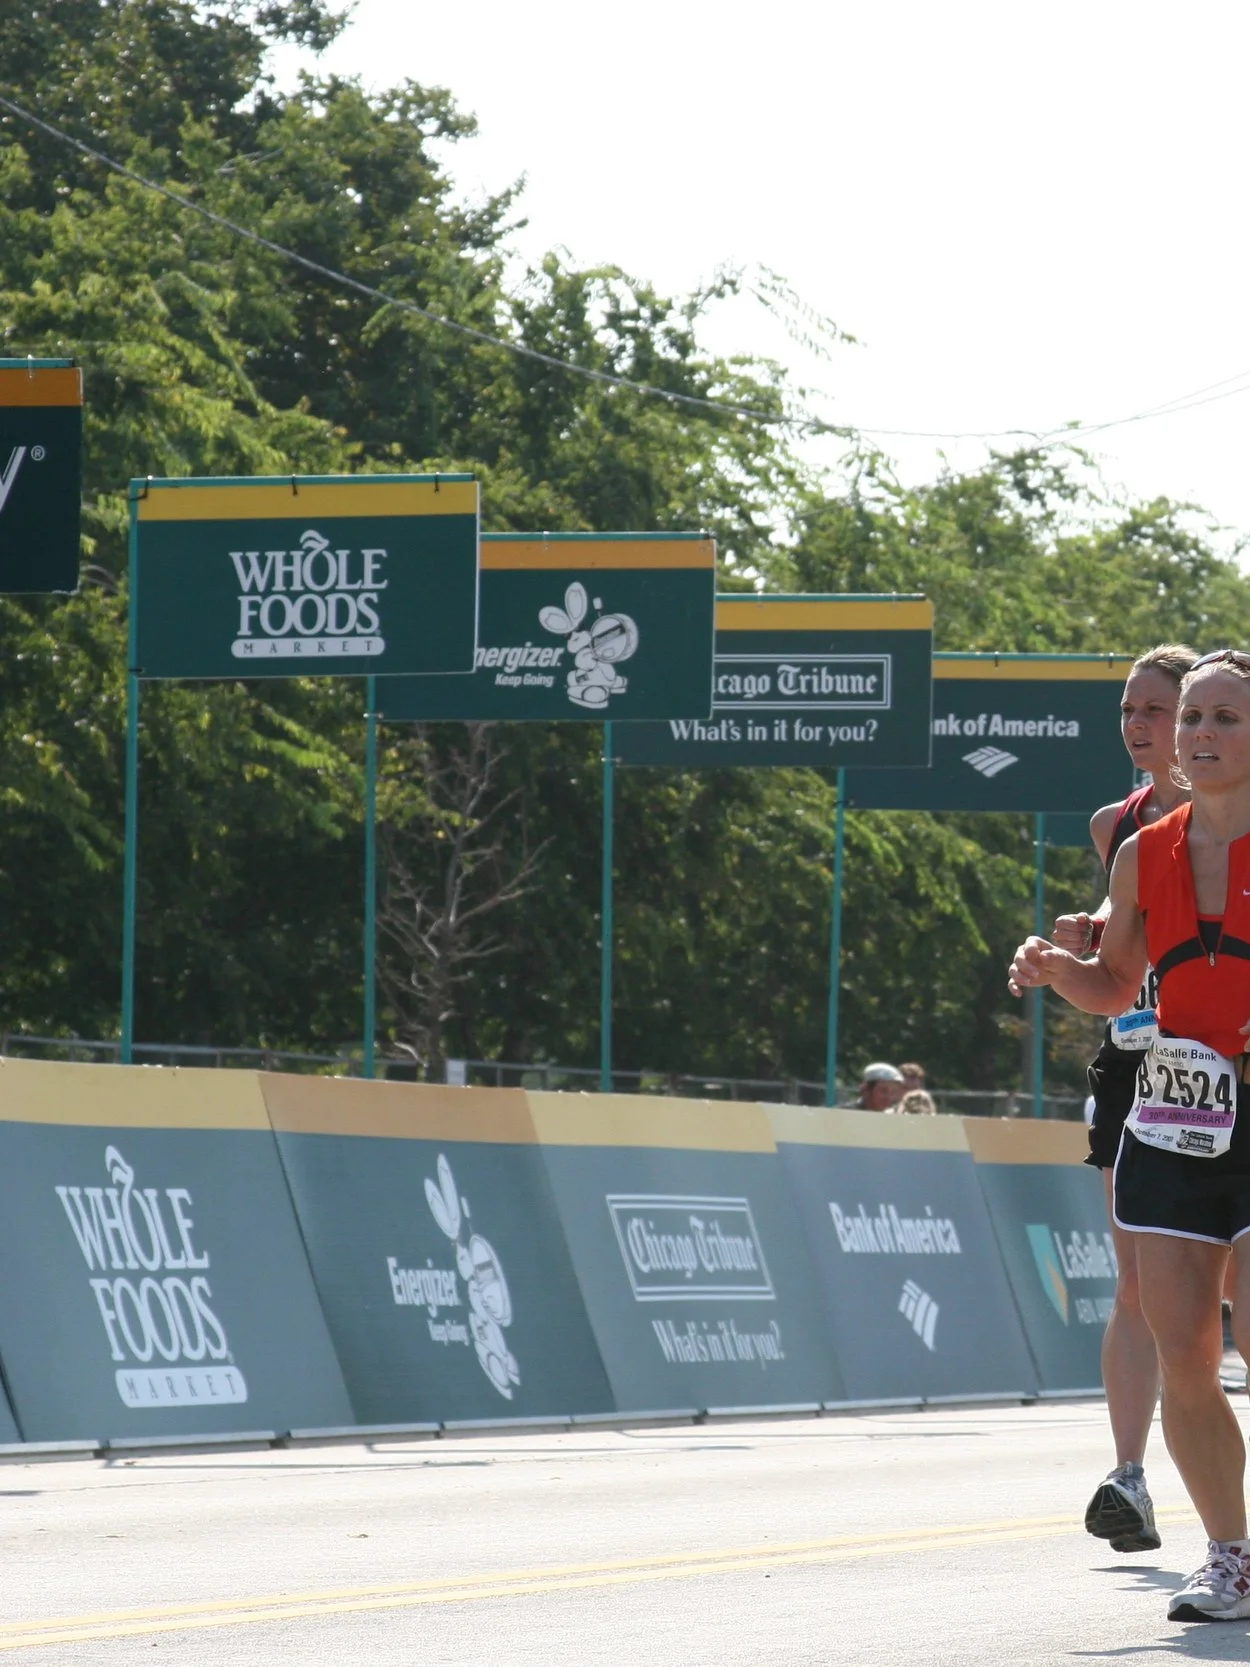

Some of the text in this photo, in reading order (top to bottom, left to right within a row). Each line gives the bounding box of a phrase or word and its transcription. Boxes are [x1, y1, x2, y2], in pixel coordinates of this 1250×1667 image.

[228, 547, 389, 592] WHOLE
[237, 592, 380, 636] FOODS
[243, 640, 374, 655] MARKET
[495, 673, 555, 689] Keep Going
[714, 664, 878, 699] cago Tribune
[669, 719, 879, 747] What's in it for you?
[933, 713, 1080, 737] nk of America
[1155, 1045, 1217, 1062] LaSalle Bank
[1156, 1064, 1233, 1115] 2524
[1167, 1112, 1228, 1125] ANNIVERSARY
[55, 1180, 210, 1271] WHOLE
[689, 1215, 758, 1273] Tribune
[828, 1202, 962, 1254] Bank of America
[1053, 1230, 1112, 1278] LaSalle
[89, 1276, 230, 1362] FOODS
[125, 1373, 237, 1400] MARKET
